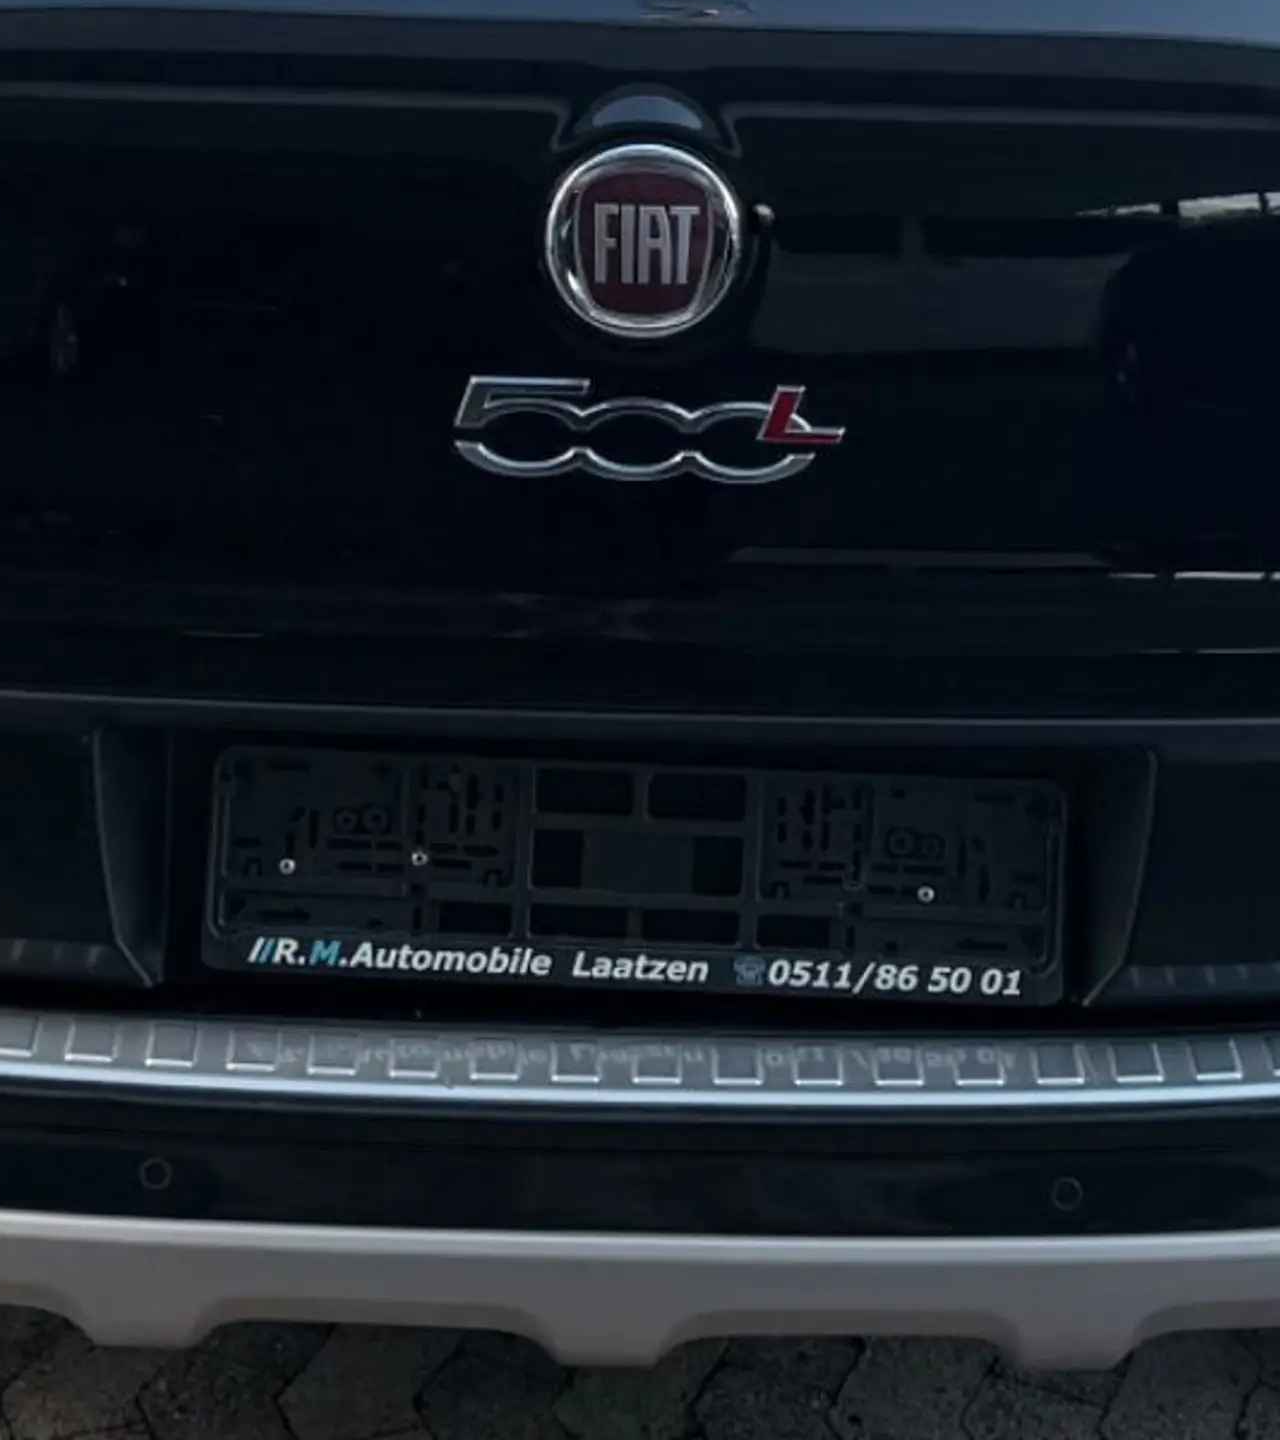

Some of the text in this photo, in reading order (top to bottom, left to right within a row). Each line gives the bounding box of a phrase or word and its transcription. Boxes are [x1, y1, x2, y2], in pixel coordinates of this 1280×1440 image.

[594, 201, 701, 285] FIAT
[571, 950, 709, 982] Laatzen
[768, 959, 919, 994] 0511/86
[927, 965, 972, 994] 50
[979, 968, 1021, 996] 01
